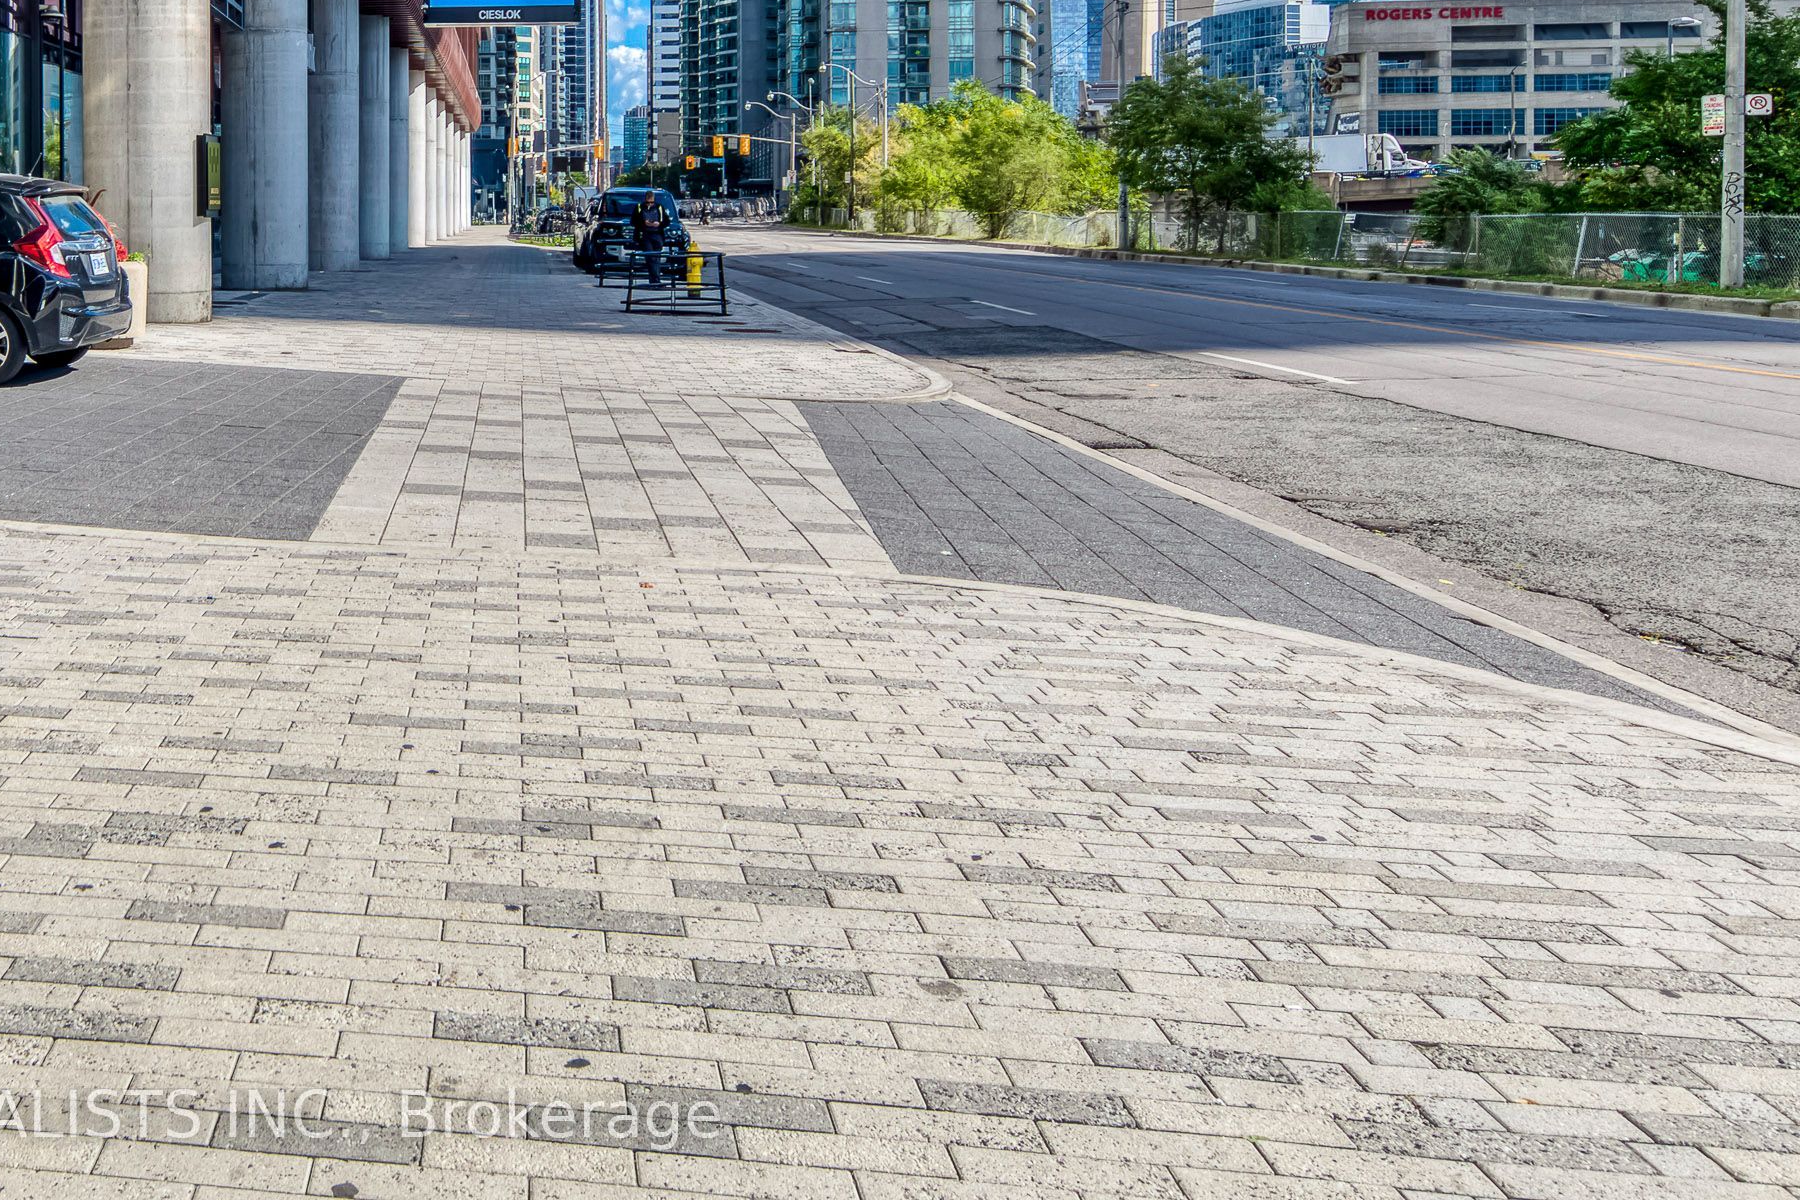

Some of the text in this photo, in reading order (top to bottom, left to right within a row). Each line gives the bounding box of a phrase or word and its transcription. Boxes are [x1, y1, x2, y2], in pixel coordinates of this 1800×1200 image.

[478, 9, 521, 20] CIESLOK
[1365, 6, 1504, 21] ROGERS CENTRE
